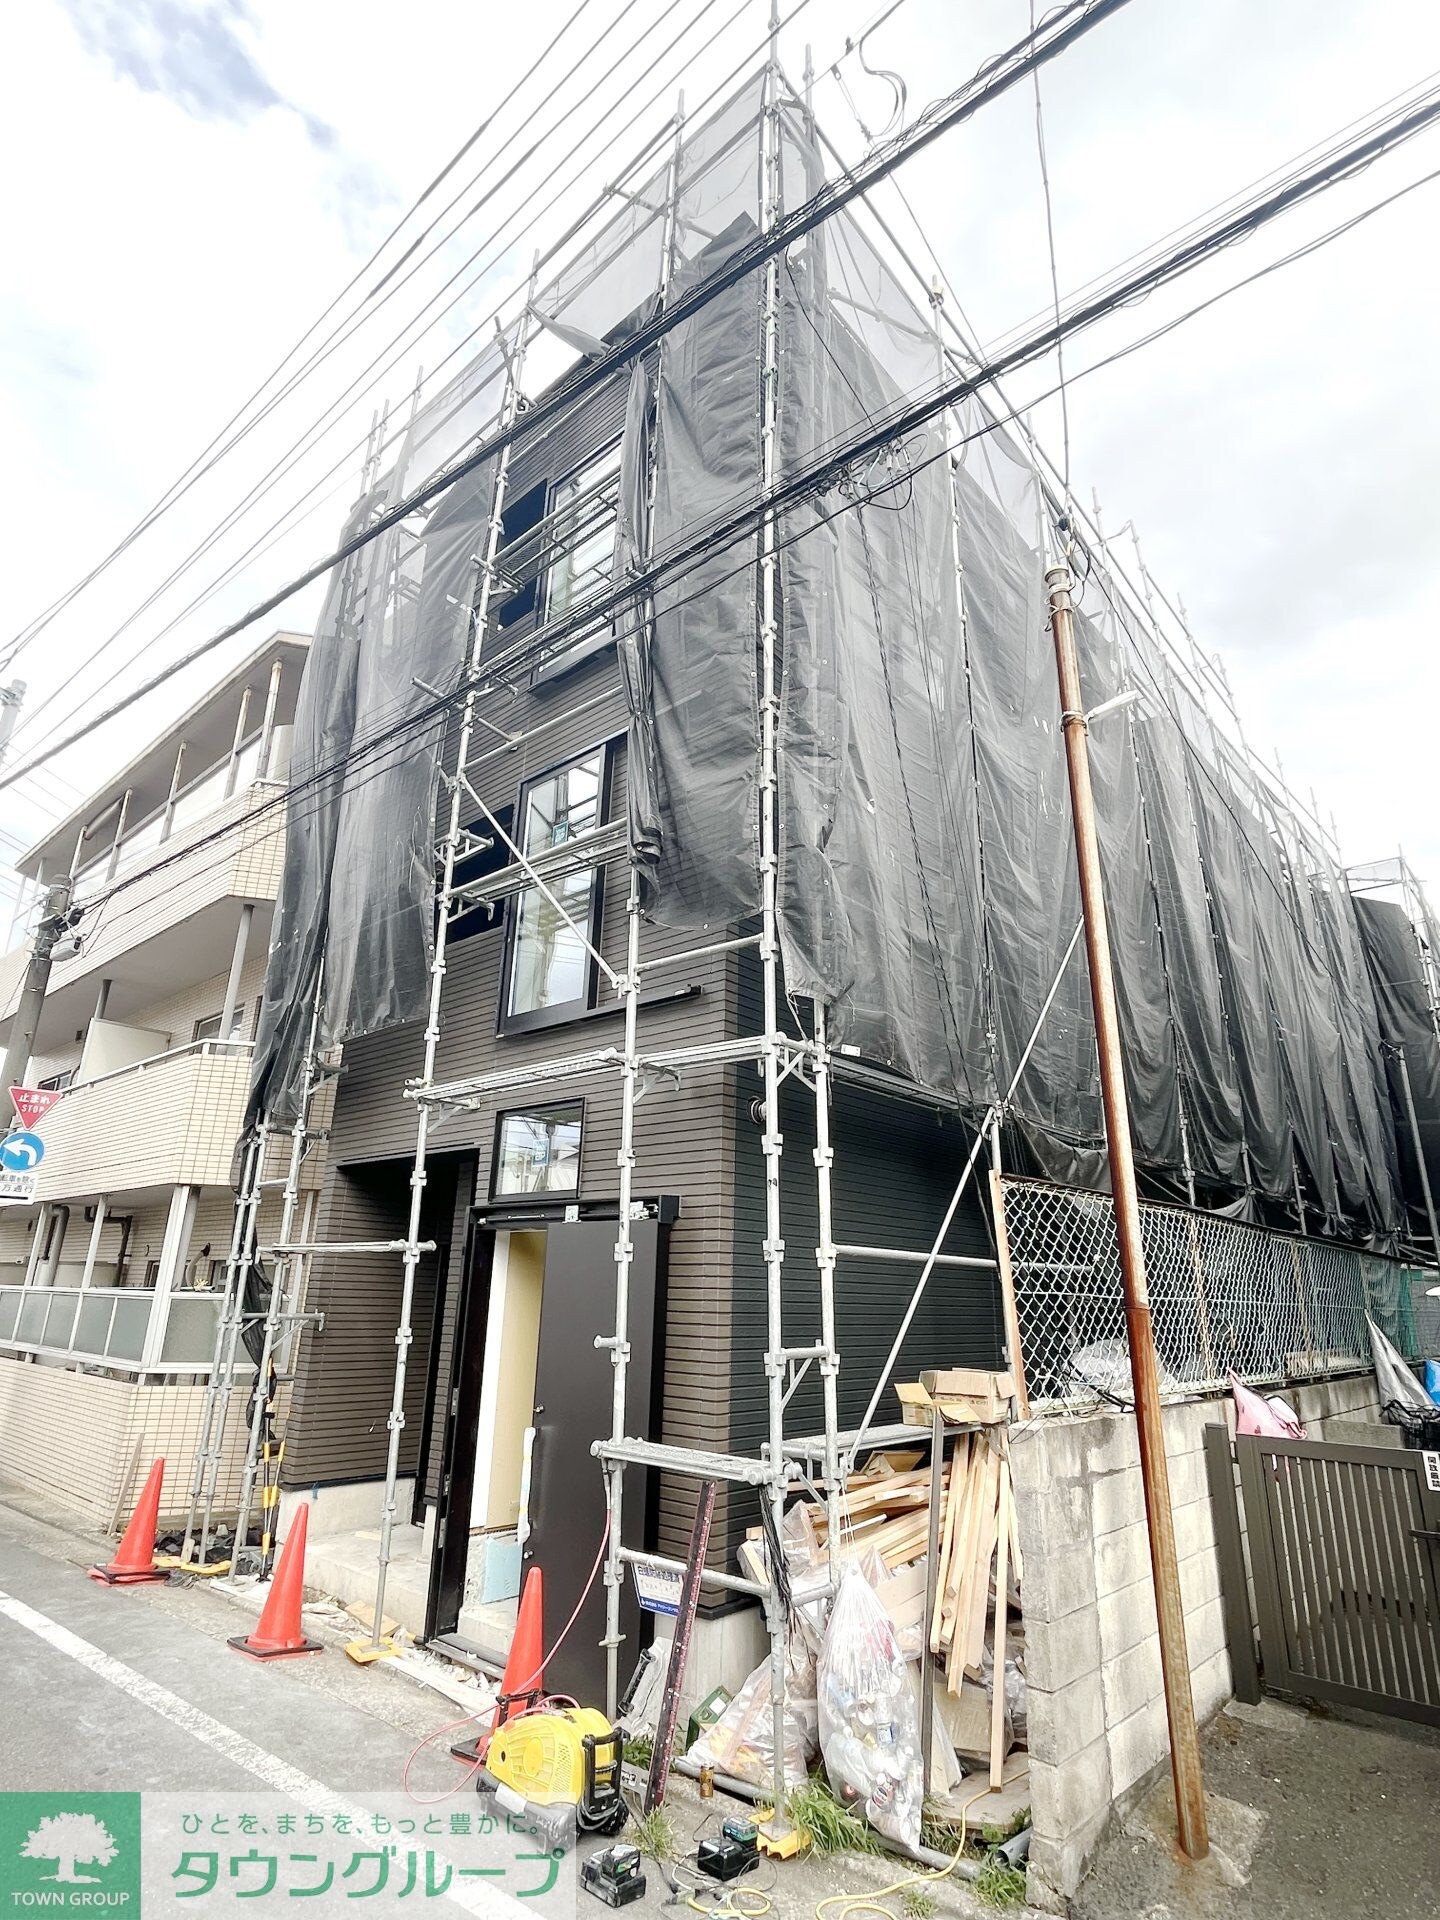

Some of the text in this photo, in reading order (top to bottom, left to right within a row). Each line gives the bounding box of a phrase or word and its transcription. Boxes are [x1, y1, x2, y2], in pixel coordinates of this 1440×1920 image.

[18, 1092, 51, 1104] 止まれ
[21, 1104, 45, 1113] STOP
[0, 1184, 33, 1193] 方通行
